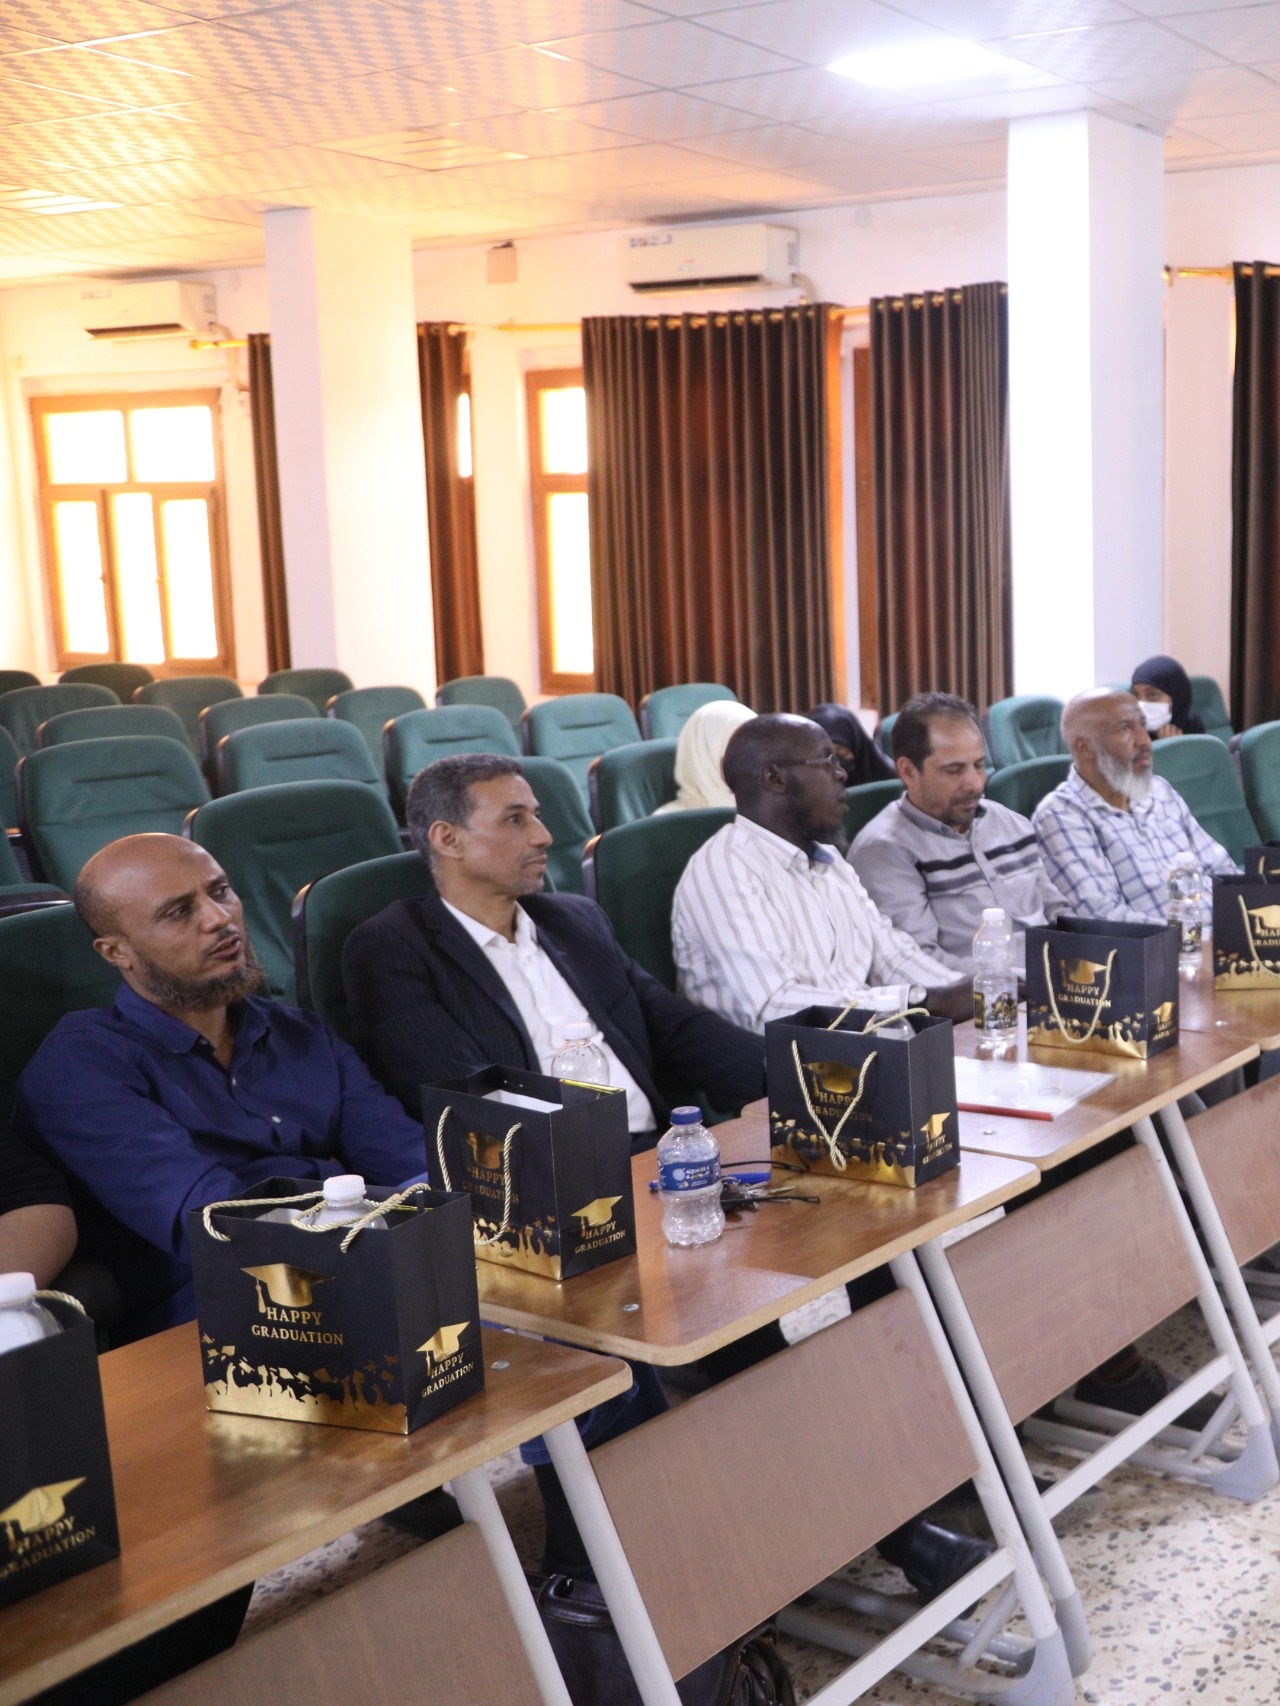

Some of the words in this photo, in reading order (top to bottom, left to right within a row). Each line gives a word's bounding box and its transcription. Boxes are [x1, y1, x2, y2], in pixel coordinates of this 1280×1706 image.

[1066, 983, 1100, 996] HAPPY
[811, 1104, 873, 1122] RADUTION
[462, 1181, 520, 1203] GRADUATIN
[585, 1221, 617, 1240] HAPPY
[574, 1229, 627, 1254] GRADUATION
[266, 1306, 322, 1326] HAPPY
[251, 1324, 344, 1345] GRADUATION
[430, 1352, 464, 1379] HAPPY
[421, 1361, 475, 1398] GRADUATION
[17, 1515, 75, 1556] HAPPY
